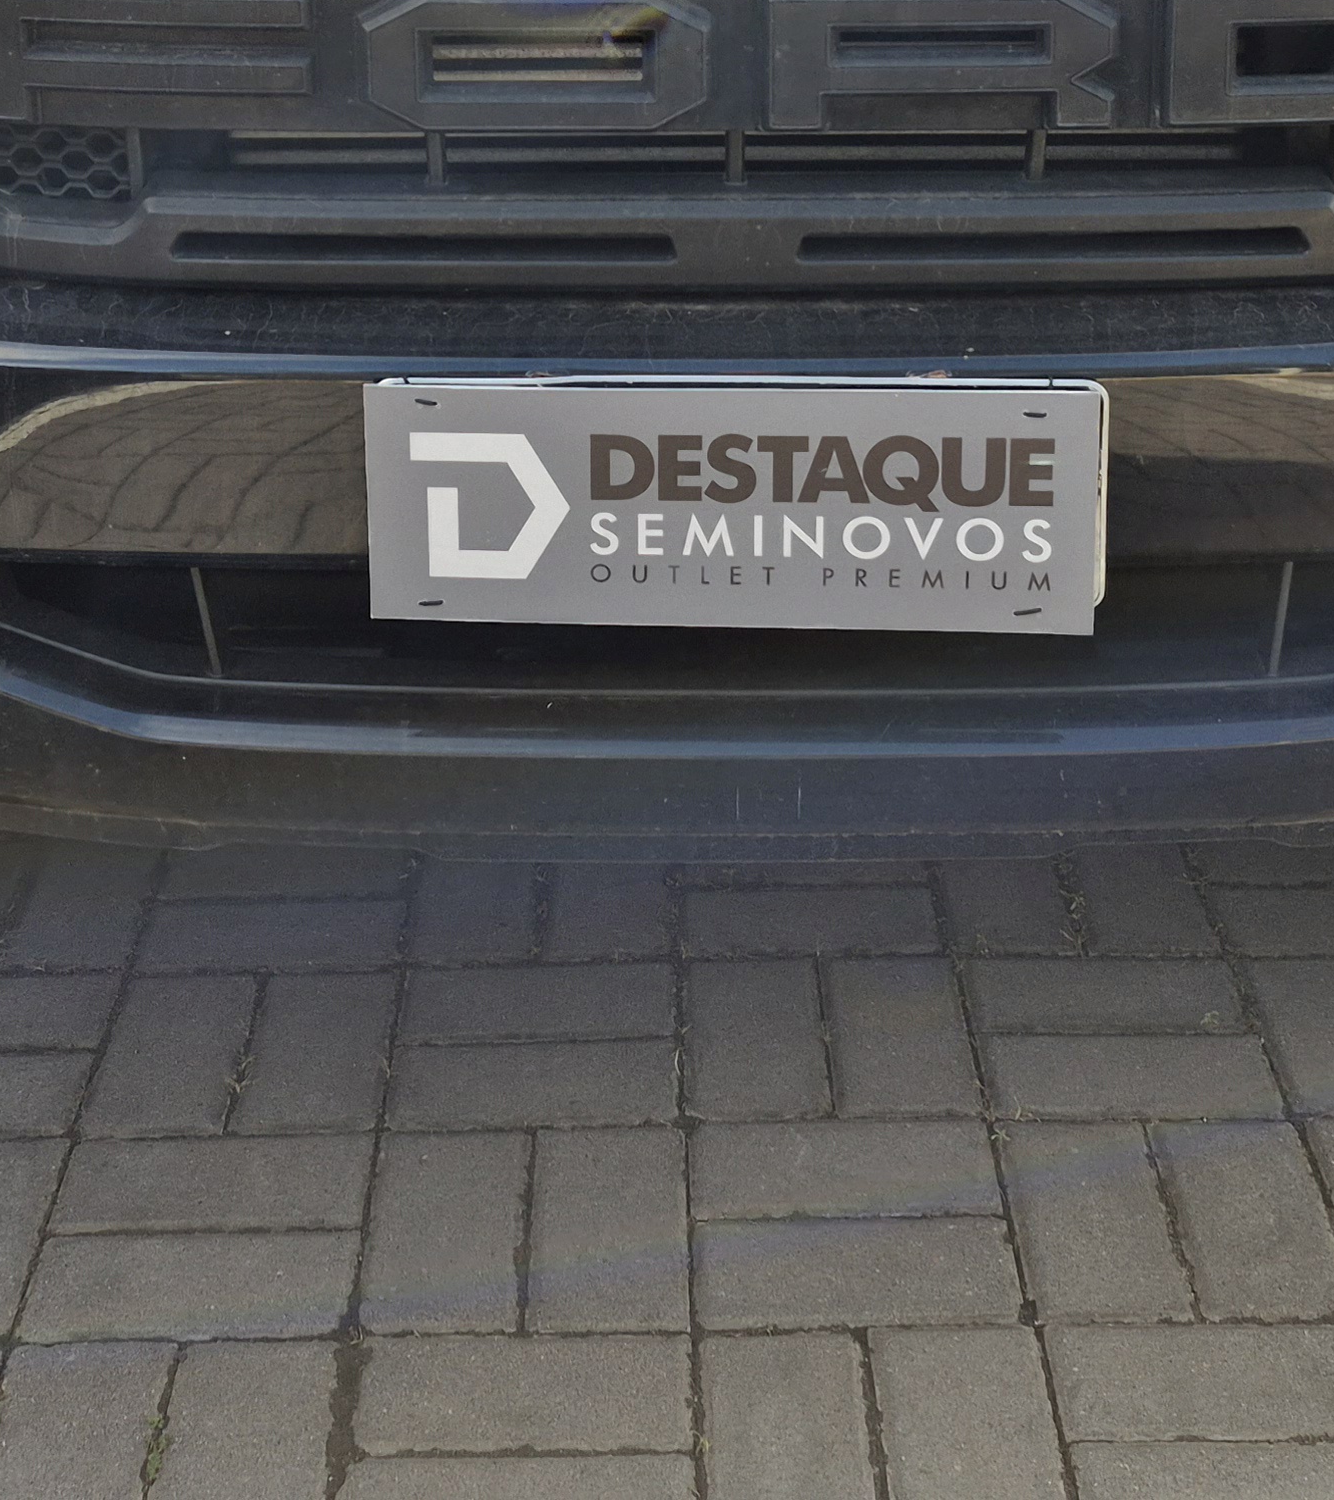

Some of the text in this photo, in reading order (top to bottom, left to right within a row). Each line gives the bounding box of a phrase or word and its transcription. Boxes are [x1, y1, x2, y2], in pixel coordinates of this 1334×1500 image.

[590, 434, 1055, 512] DESTAQUE
[590, 512, 1054, 564] SEMINOVOS
[591, 563, 1052, 592] OUTLET PREMIUM
